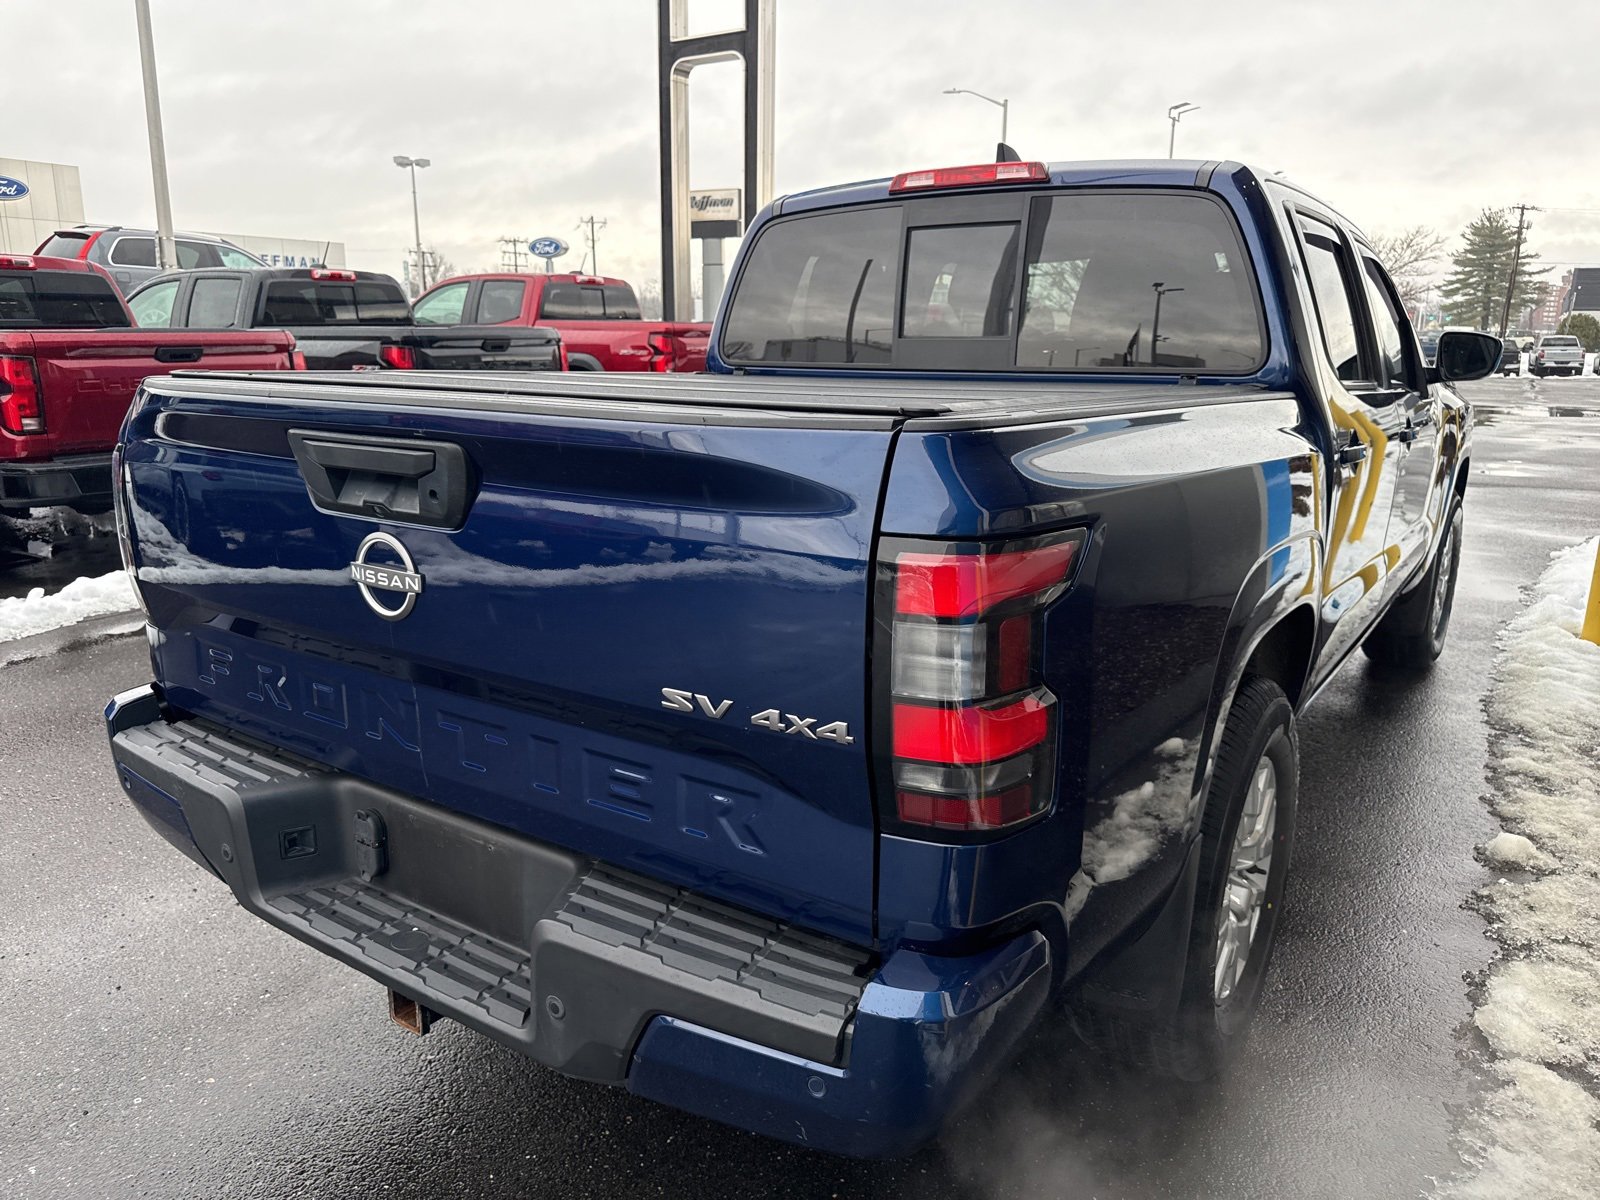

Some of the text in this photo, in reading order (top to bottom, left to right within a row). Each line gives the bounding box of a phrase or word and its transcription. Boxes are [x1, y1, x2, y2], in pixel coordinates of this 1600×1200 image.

[534, 241, 556, 254] Ford
[351, 564, 420, 591] NISSAN
[661, 687, 734, 720] SV
[195, 638, 768, 857] FRONTIER
